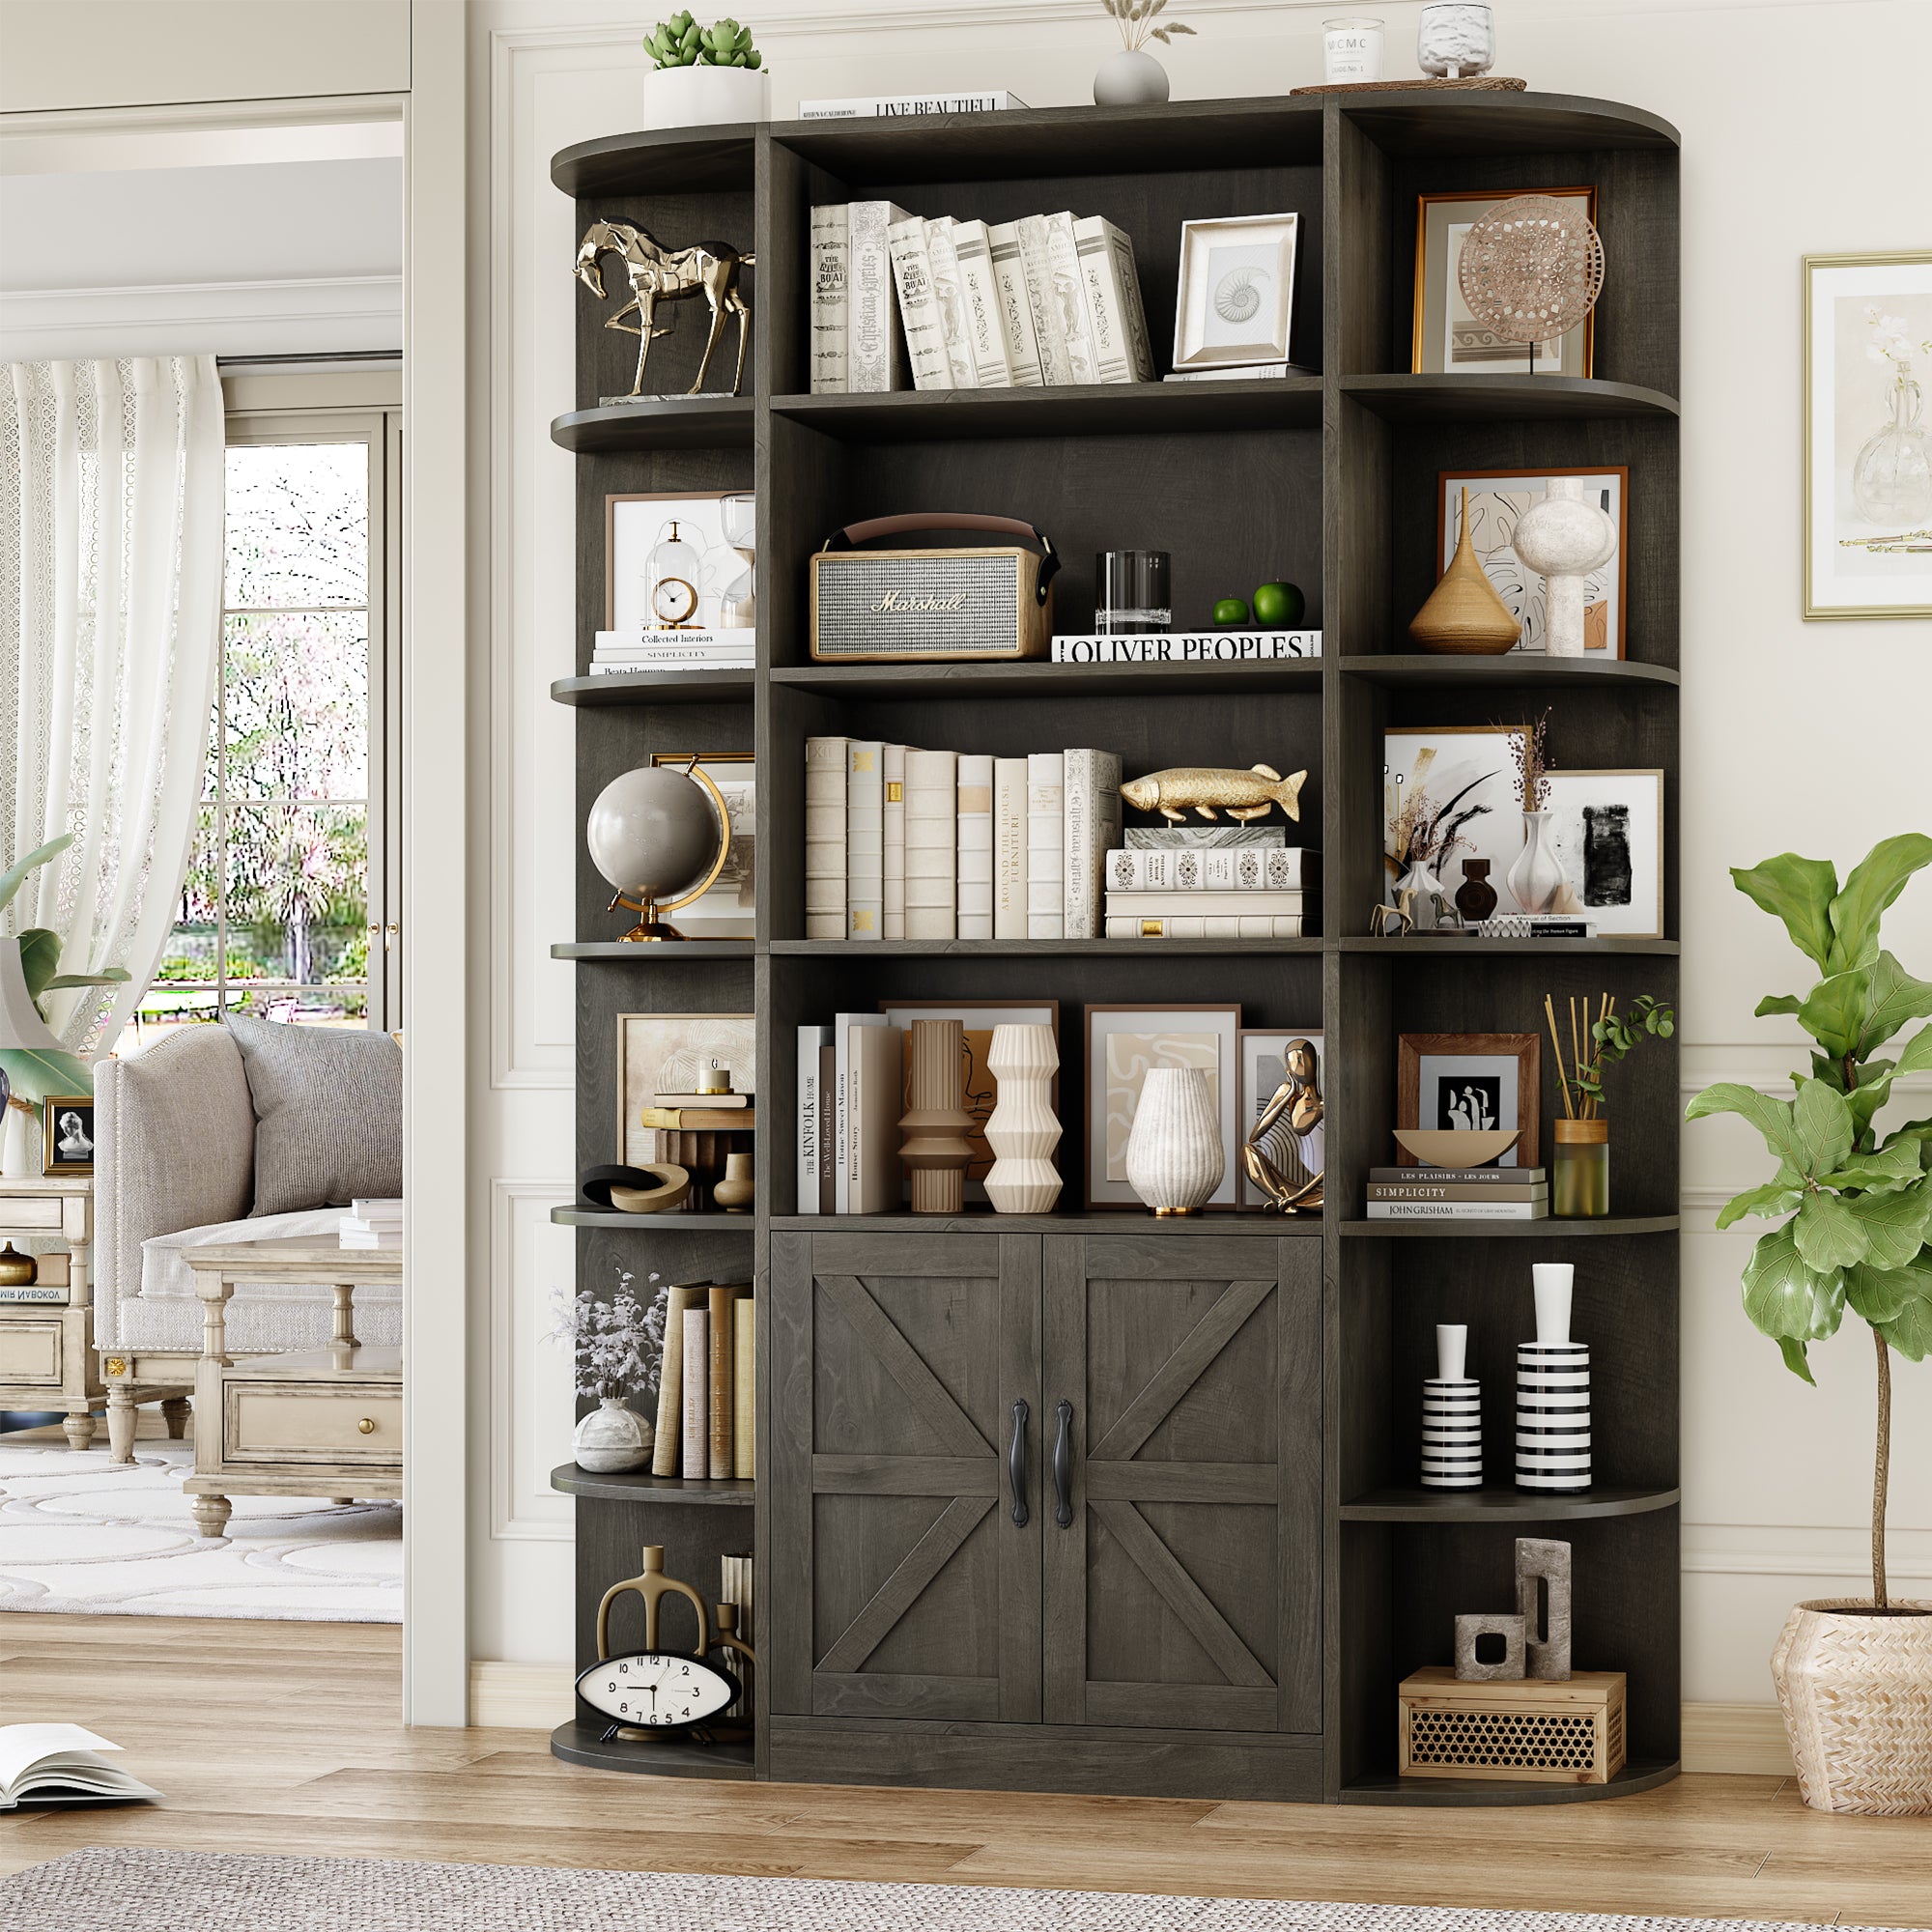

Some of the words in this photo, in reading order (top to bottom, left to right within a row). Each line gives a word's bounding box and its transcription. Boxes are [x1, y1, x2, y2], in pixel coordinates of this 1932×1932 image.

[1327, 39, 1367, 50] MCMC
[876, 102, 910, 117] LIVE
[915, 98, 1001, 116] BEAUTIFUL
[870, 589, 967, 611] Marshall
[641, 635, 678, 643] Collected
[680, 634, 714, 643] Interiors
[1071, 638, 1171, 662] OLIVER
[1182, 636, 1302, 661] PEOPLES
[1010, 813, 1019, 883] FURNITURE
[803, 1101, 814, 1157] KINFOLK
[851, 1125, 860, 1151] Story
[1376, 1187, 1446, 1197] SIMPLICITY
[637, 1657, 643, 1666] 11
[649, 1655, 661, 1665] 12
[667, 1659, 670, 1667] 1
[619, 1663, 629, 1673] 10
[681, 1665, 690, 1676] 2
[608, 1682, 616, 1692] 9
[692, 1687, 700, 1697] 3
[619, 1702, 628, 1713] 8
[681, 1707, 690, 1717] 4
[636, 1712, 642, 1721] 7
[649, 1715, 657, 1724] 6
[665, 1714, 672, 1723] 5
